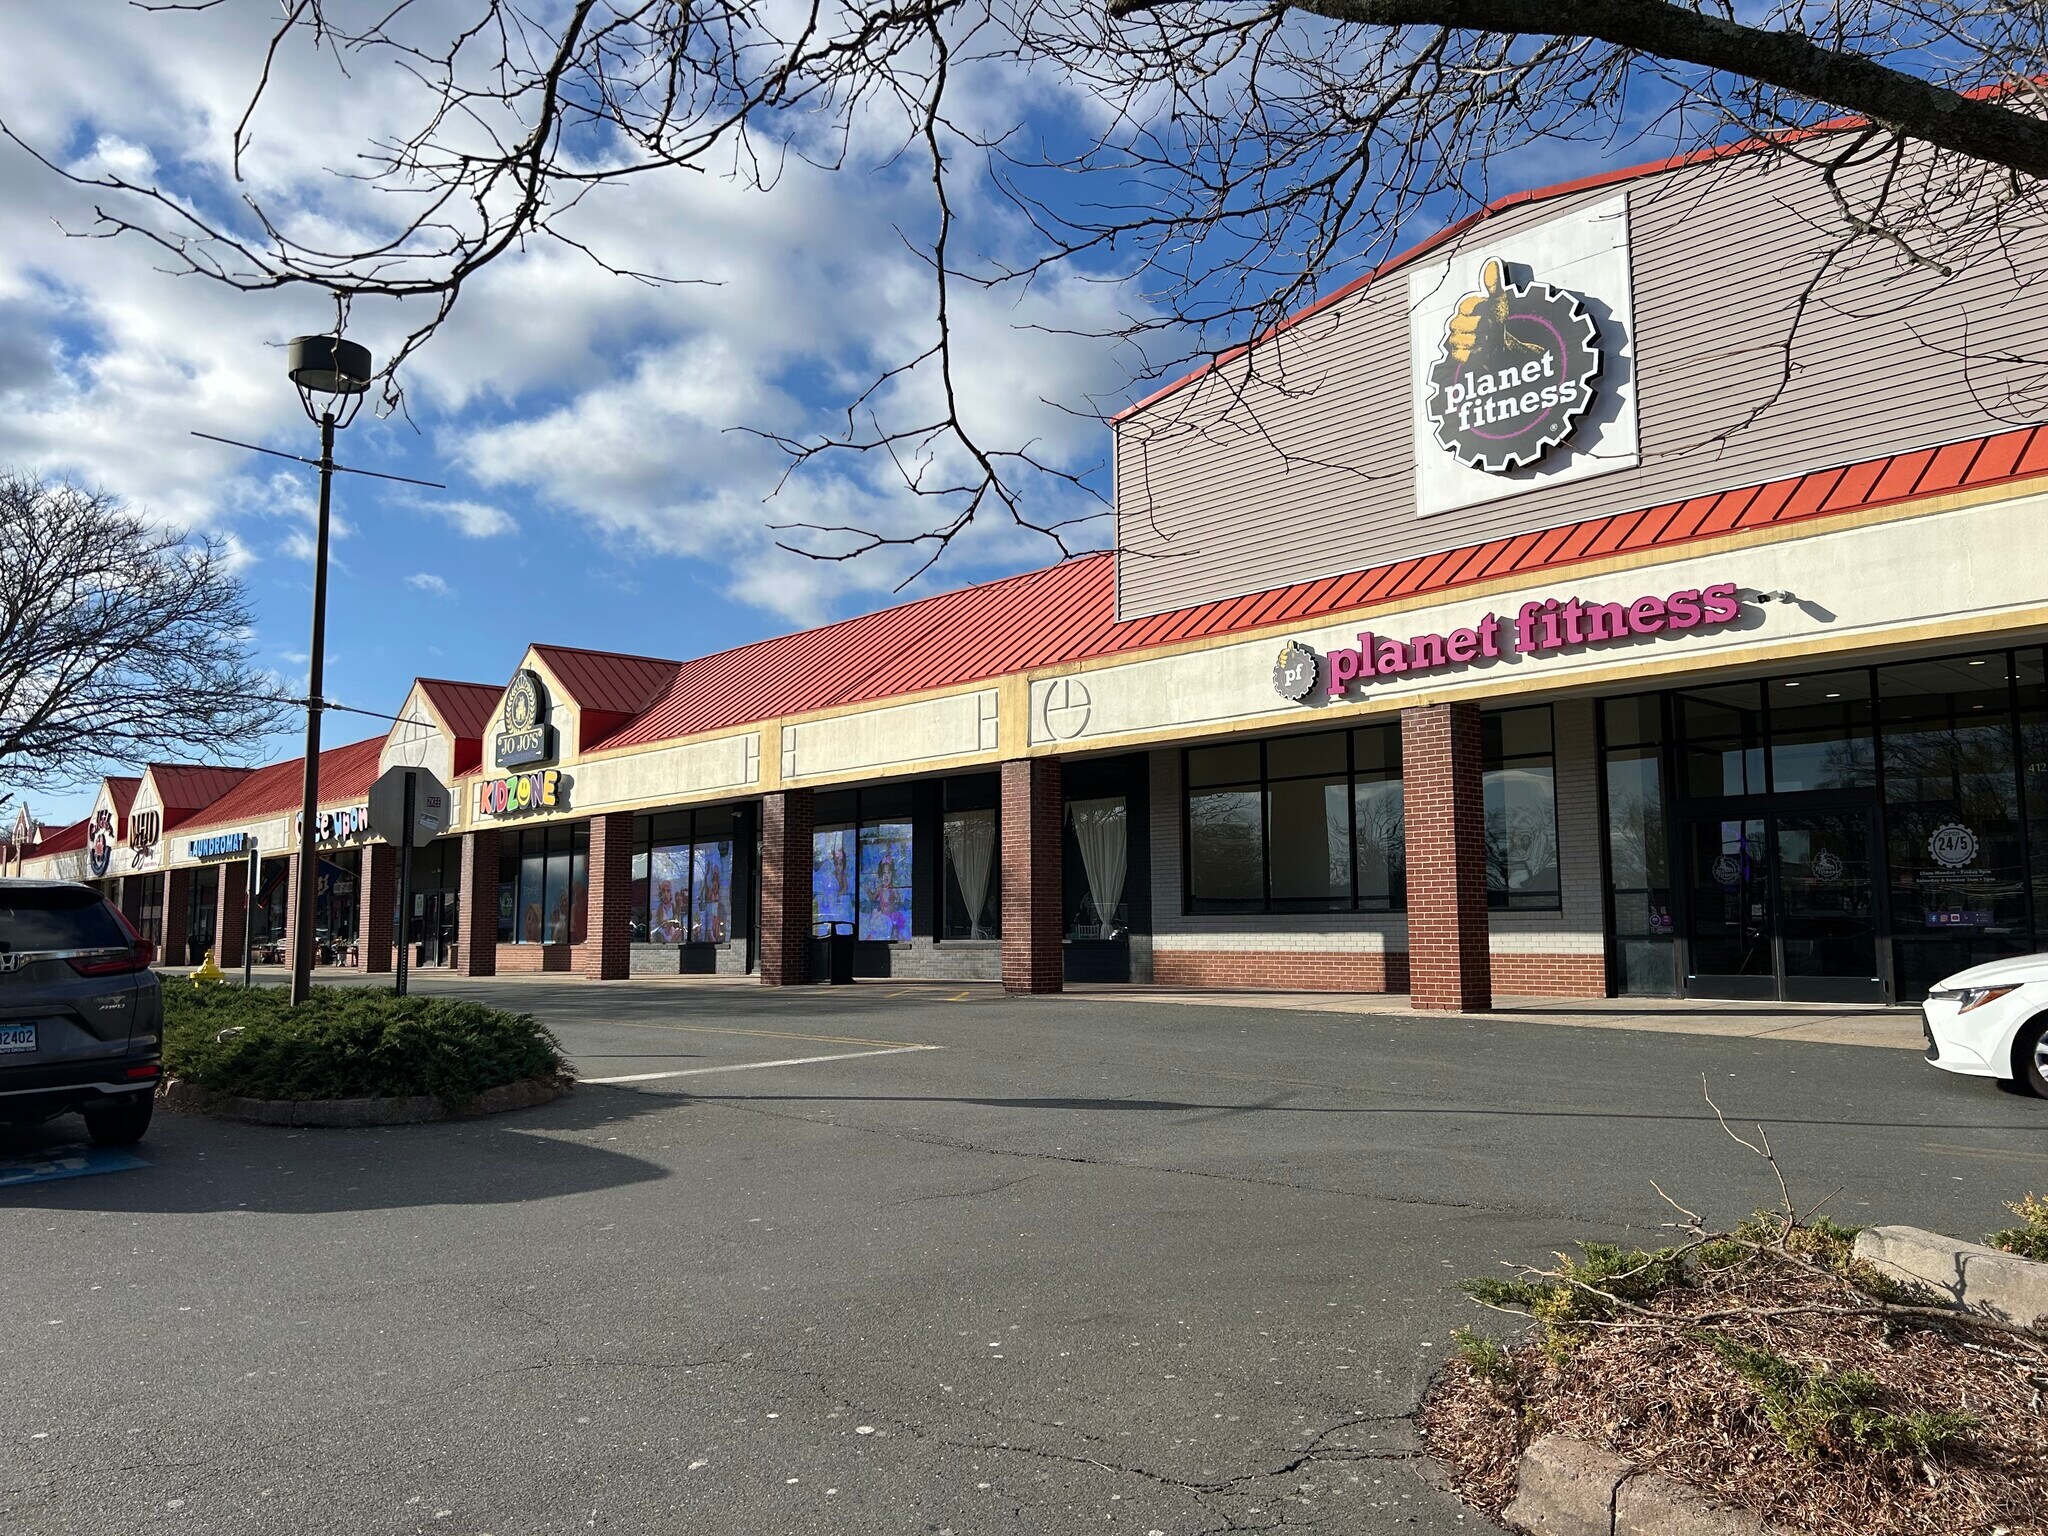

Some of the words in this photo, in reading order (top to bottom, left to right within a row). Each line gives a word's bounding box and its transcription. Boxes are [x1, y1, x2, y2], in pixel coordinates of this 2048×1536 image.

[1444, 349, 1555, 415] planet
[1458, 379, 1578, 432] fitness
[1327, 613, 1502, 695] planet
[1514, 582, 1740, 655] fitness
[1284, 663, 1303, 687] pf
[501, 737, 515, 755] JO
[516, 731, 539, 751] JO'S
[2028, 762, 2047, 773] 412
[480, 769, 560, 814] KIDZONE
[294, 811, 330, 843] Oce
[334, 806, 368, 841] upon
[188, 832, 244, 857] LAUNDROMAT
[1938, 836, 1967, 851] 24/5
